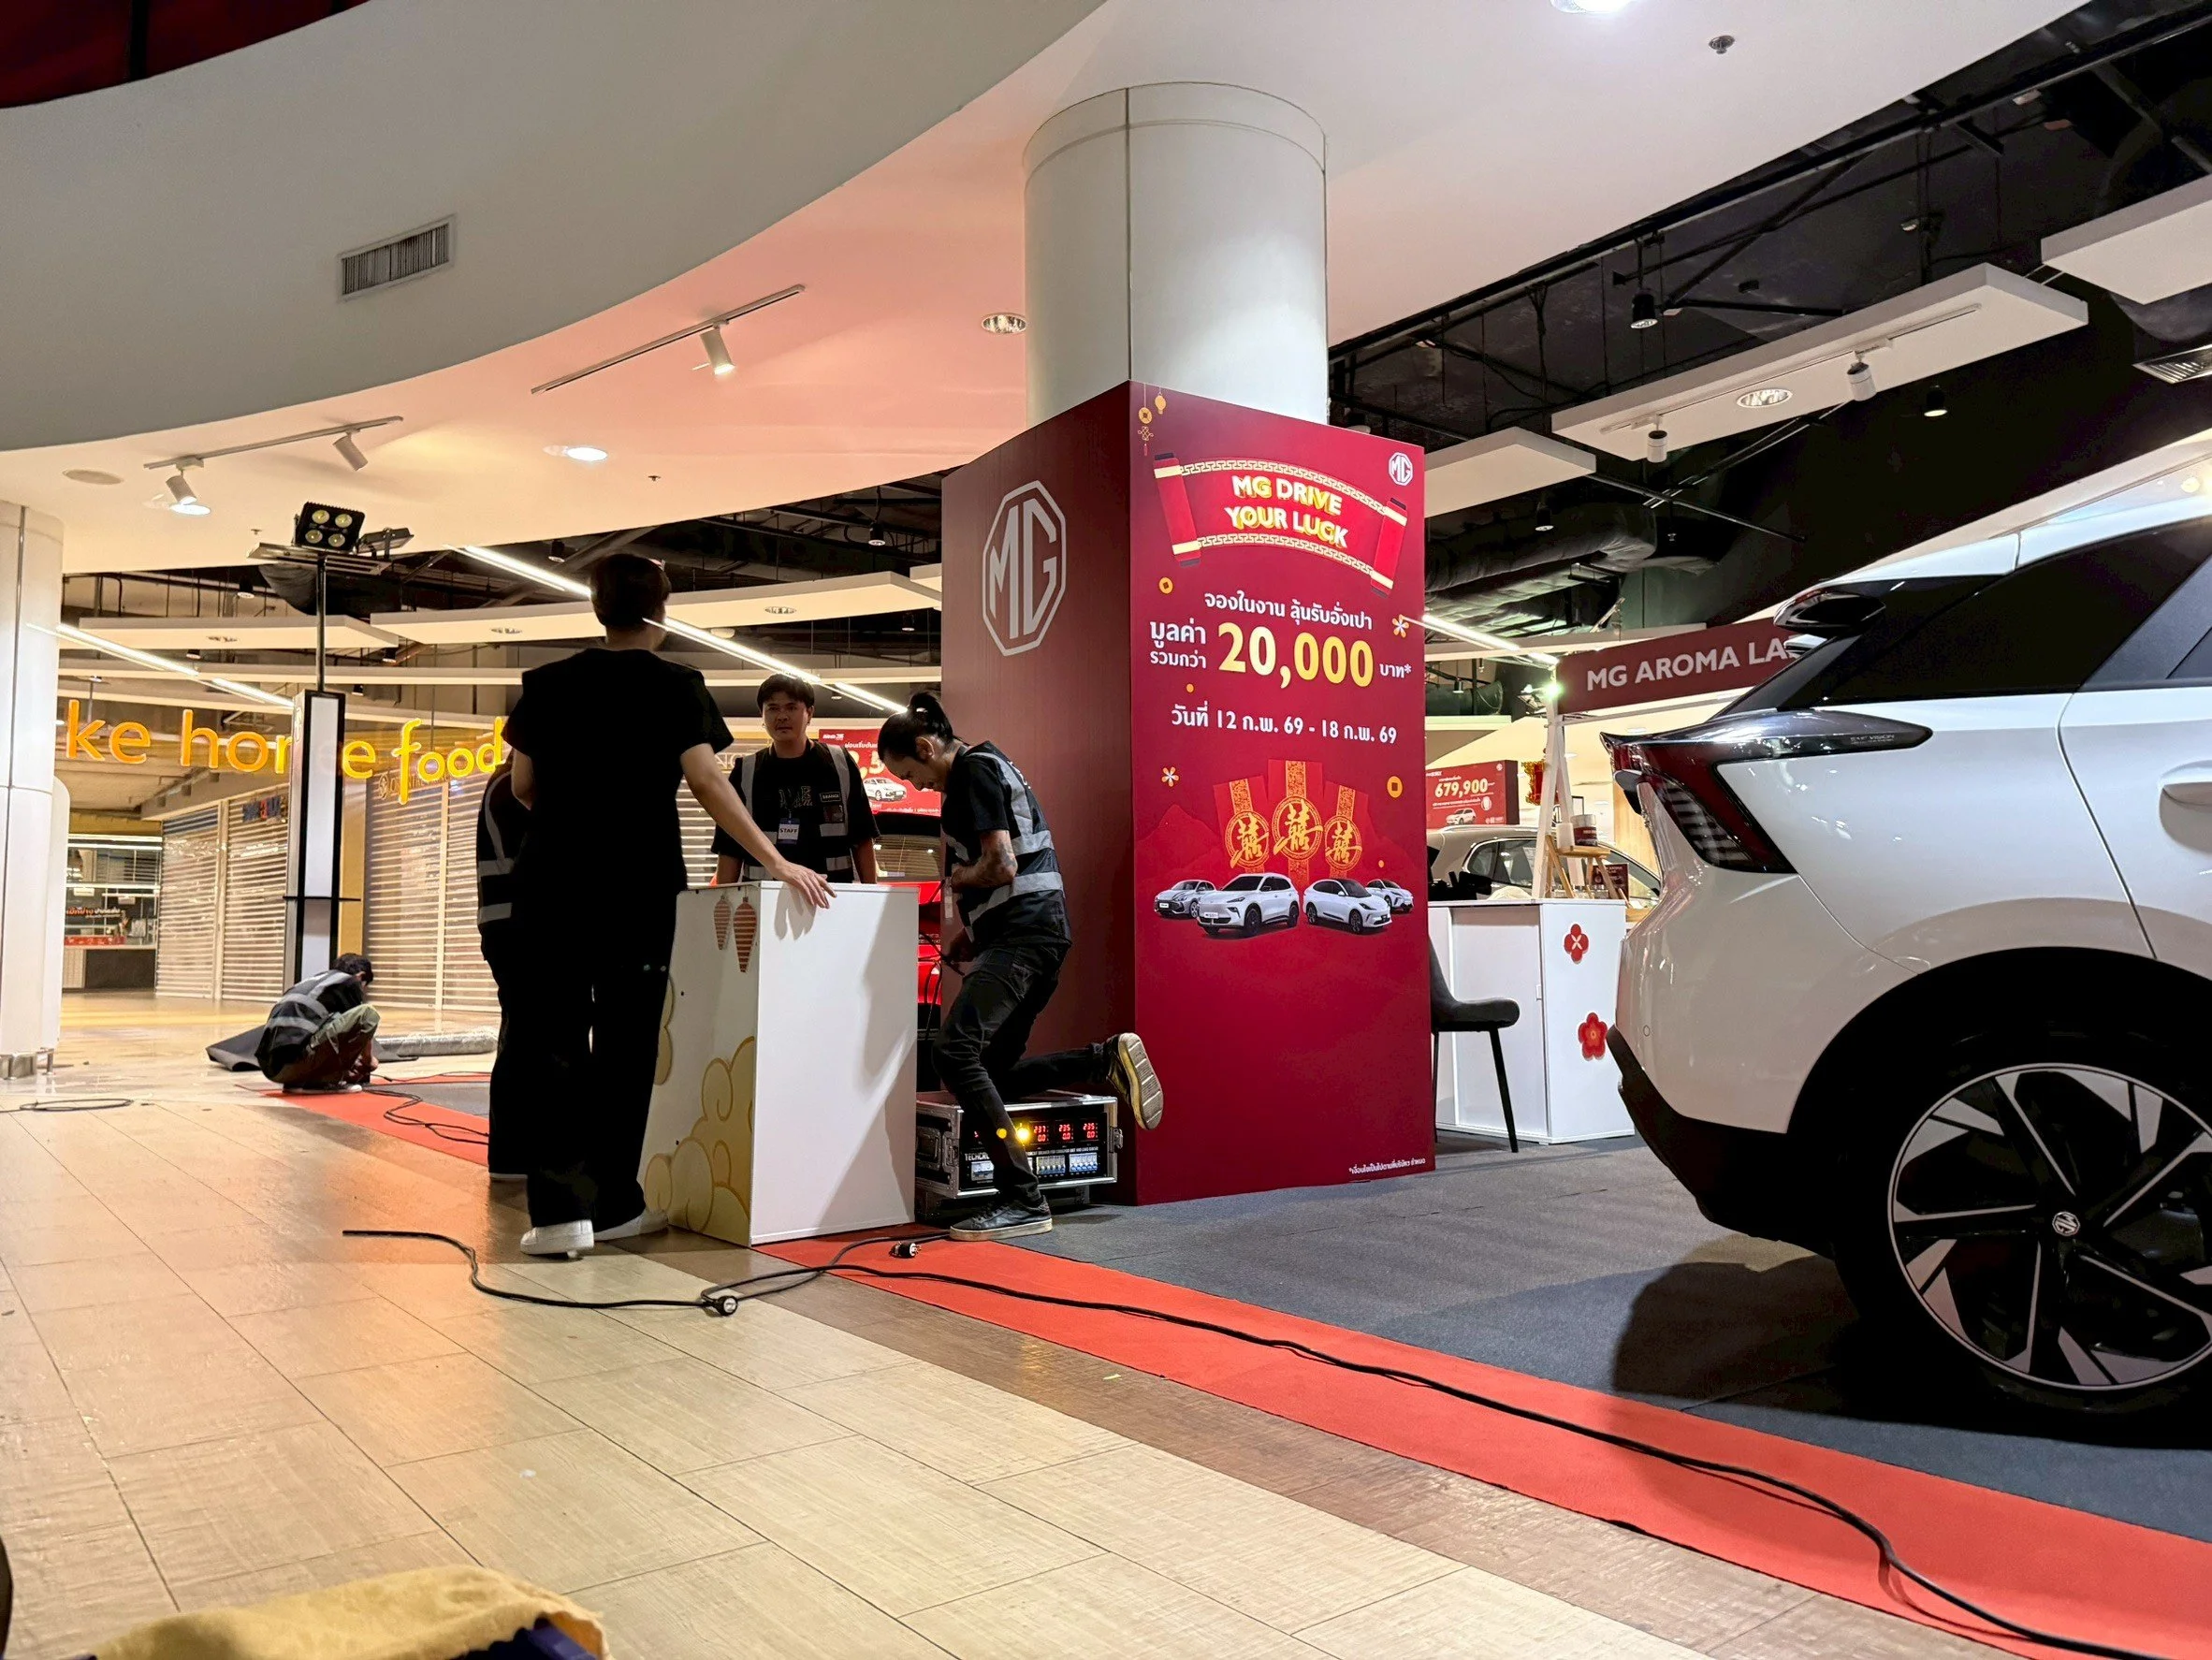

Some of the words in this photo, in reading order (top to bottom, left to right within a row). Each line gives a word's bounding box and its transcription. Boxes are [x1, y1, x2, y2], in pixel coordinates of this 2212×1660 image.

[1390, 455, 1413, 482] MG
[1231, 475, 1272, 499] MG
[1276, 478, 1343, 516] DRIVE
[1224, 505, 1288, 530] YOUR
[1292, 511, 1349, 548] LUCK
[986, 490, 1060, 647] MG
[1204, 590, 1286, 618] จองในงาน
[1290, 599, 1373, 630] ลุ้นรับอั่งเปา
[1150, 618, 1206, 648] มูลค่า
[1150, 648, 1207, 668] รวมกว่า
[1218, 621, 1374, 689] 20,000
[1587, 665, 1627, 691] MG
[1635, 647, 1740, 684] AROMA
[1748, 637, 1797, 665] LA
[1171, 700, 1209, 728] วันที่
[1217, 709, 1237, 730] 12
[1242, 715, 1279, 734] ก.พ.
[1284, 717, 1303, 735] 69
[1321, 720, 1339, 738] 18
[1344, 724, 1375, 742] ก.พ.
[1379, 726, 1397, 744] 69
[66, 699, 152, 764] ke
[181, 708, 377, 779] hoe
[391, 716, 504, 804] food
[1434, 778, 1489, 798] 679,900
[1033, 1125, 1046, 1133] 237
[1058, 1124, 1070, 1132] 235
